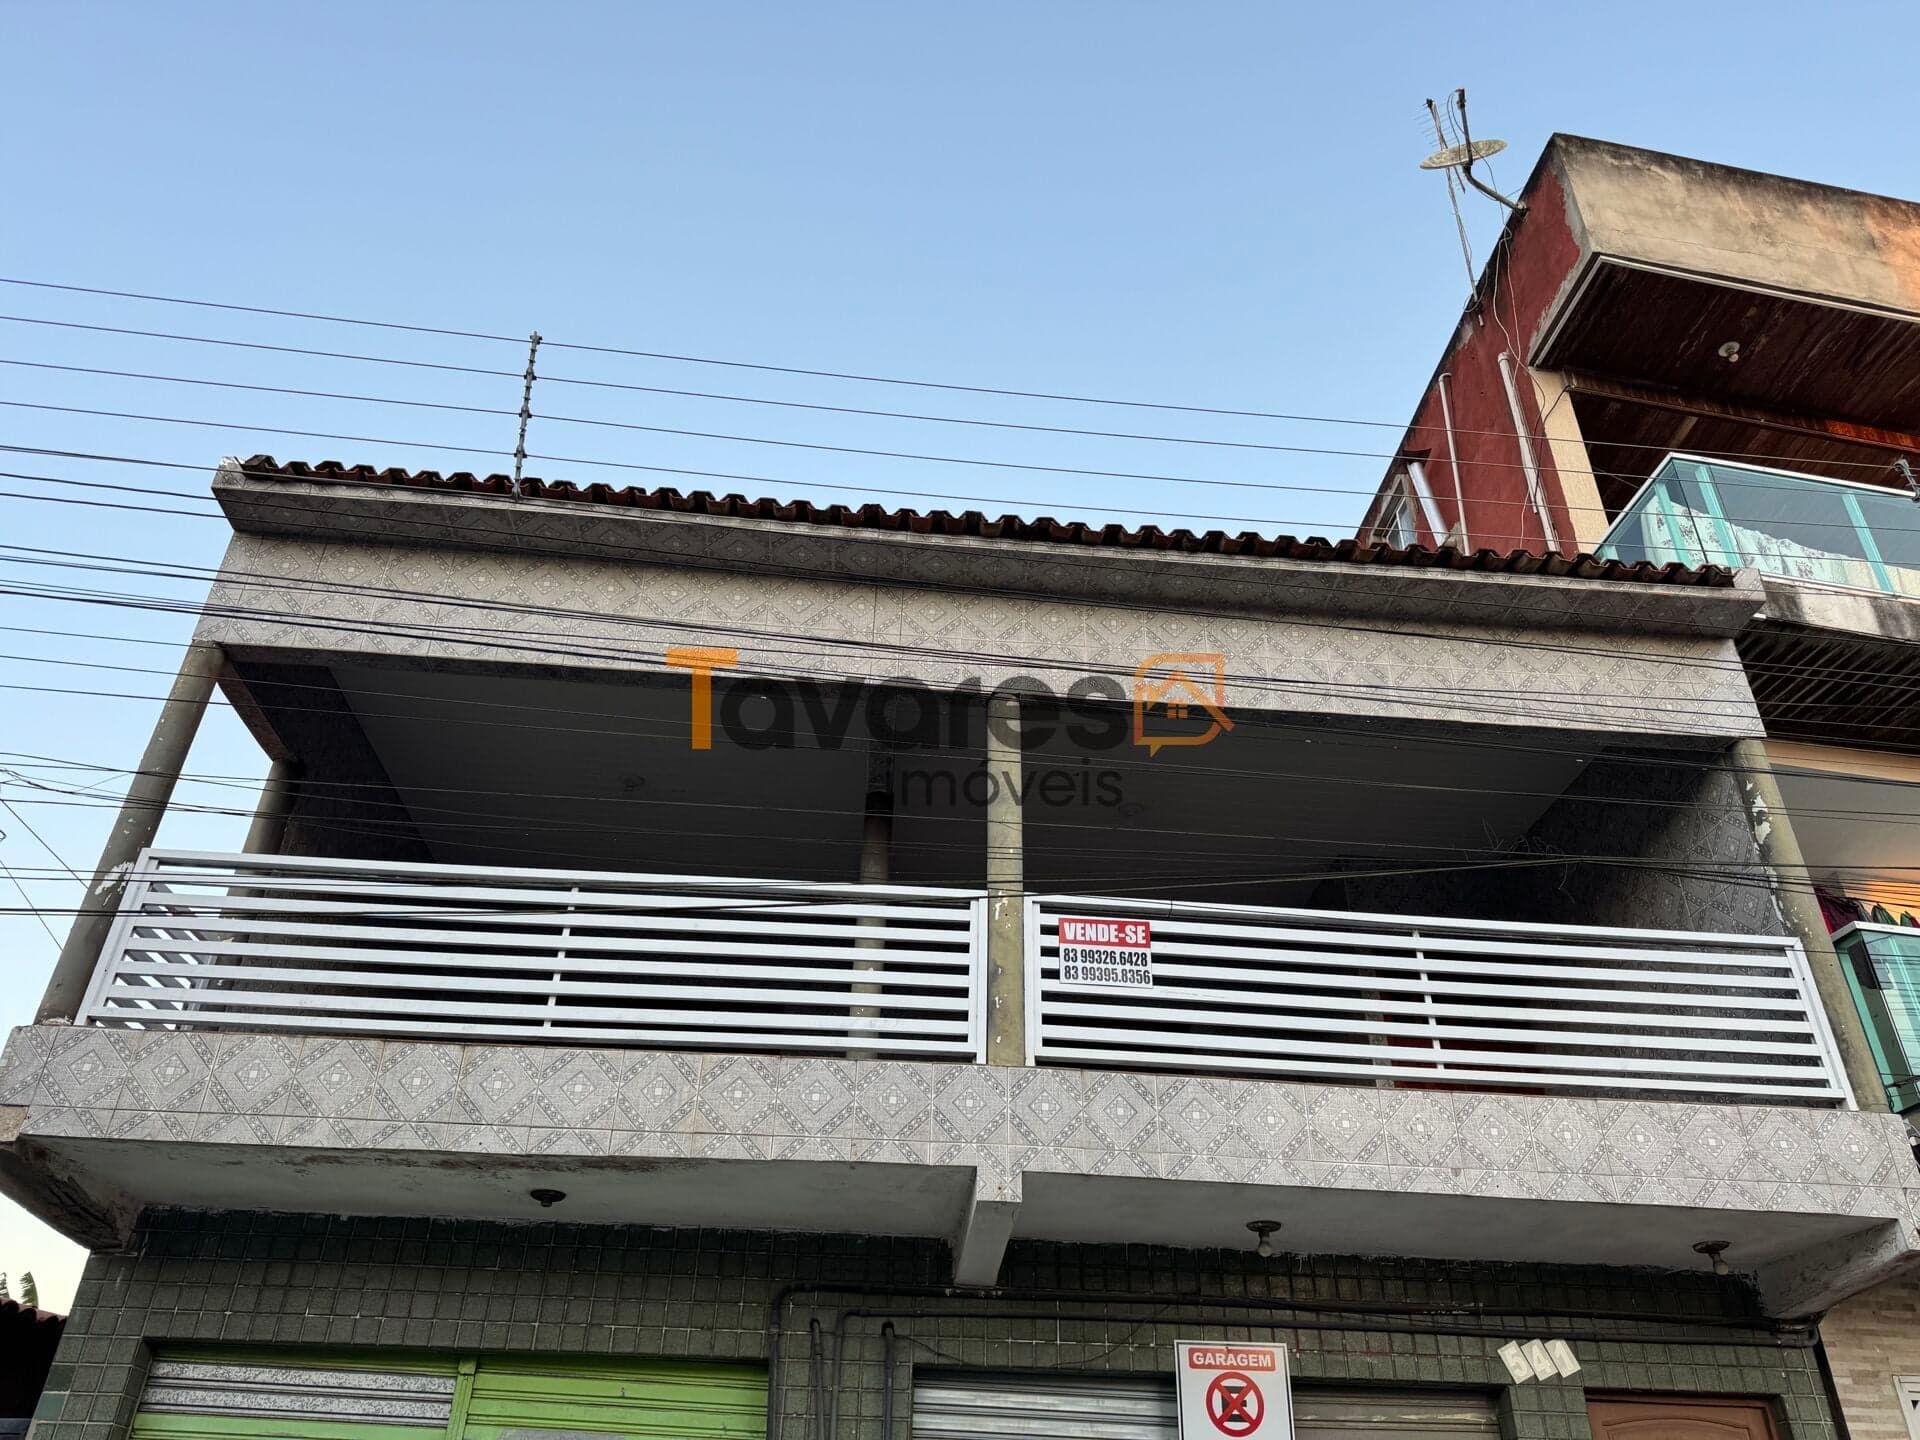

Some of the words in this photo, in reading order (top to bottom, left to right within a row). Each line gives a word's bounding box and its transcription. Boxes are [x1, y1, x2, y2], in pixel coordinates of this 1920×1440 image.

[1063, 922, 1147, 944] VENDE-SE
[1063, 948, 1078, 963] 83
[1081, 949, 1148, 967] 99326.6428
[1064, 965, 1079, 980] 83
[1081, 966, 1151, 984] 99395.8356
[1193, 1352, 1272, 1367] GARAGEM
[1503, 1341, 1575, 1378] 541
